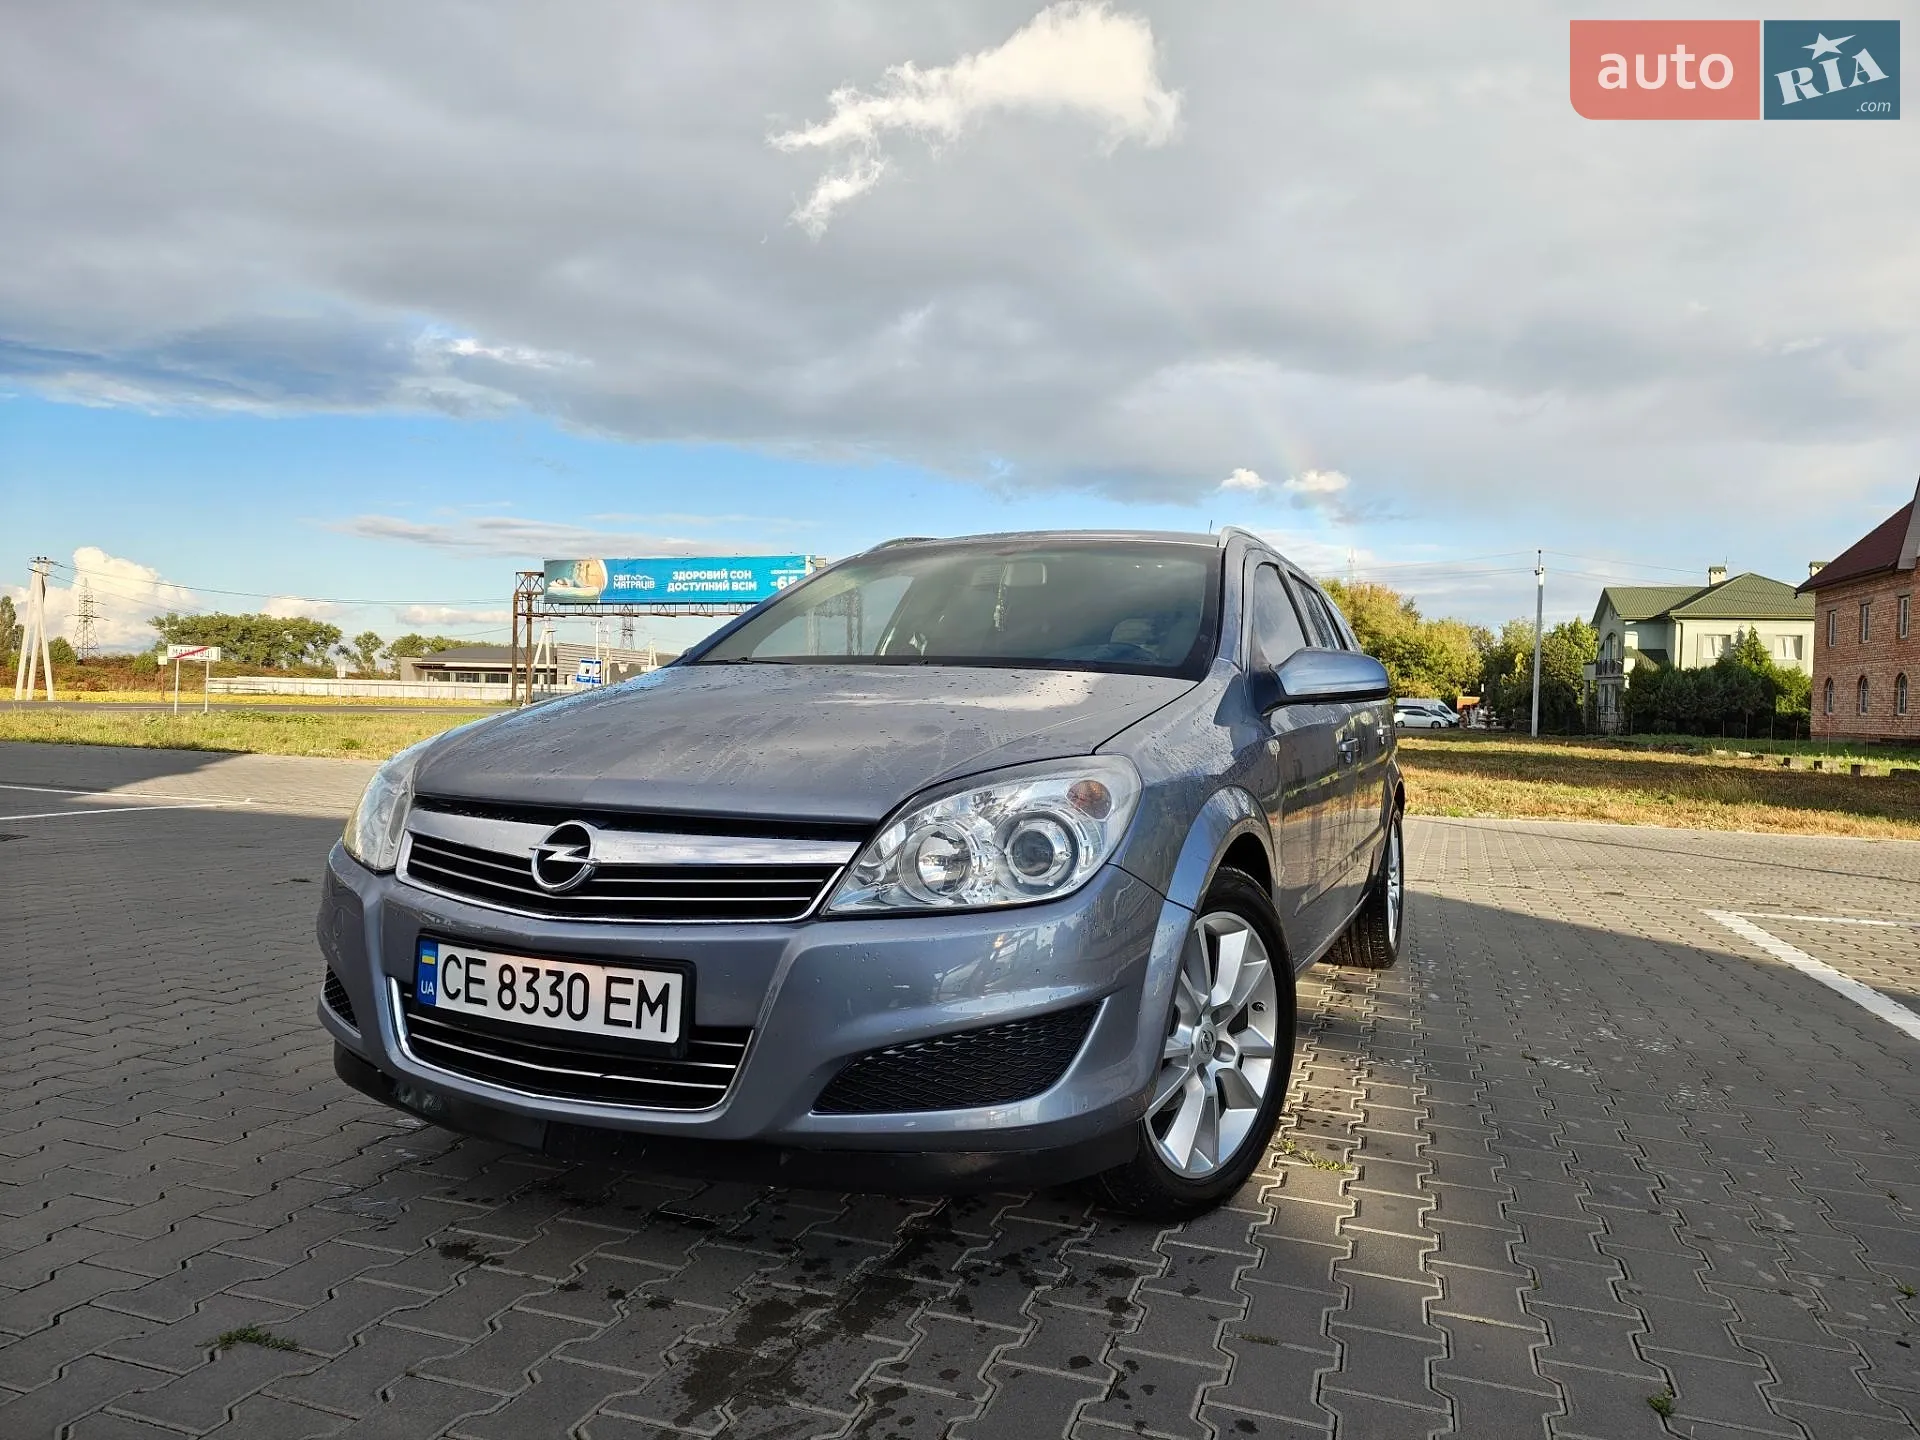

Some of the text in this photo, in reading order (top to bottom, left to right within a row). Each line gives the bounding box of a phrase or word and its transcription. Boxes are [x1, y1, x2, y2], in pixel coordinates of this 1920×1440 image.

[672, 568, 752, 581] ЗДОРОВИЙ СОН
[613, 580, 656, 590] МАТРАЦІВ
[667, 580, 730, 592] ДОСТУПНИЙ
[731, 581, 758, 591] ВСІМ
[420, 979, 435, 996] UA
[441, 953, 670, 1033] CE 8330 EM
